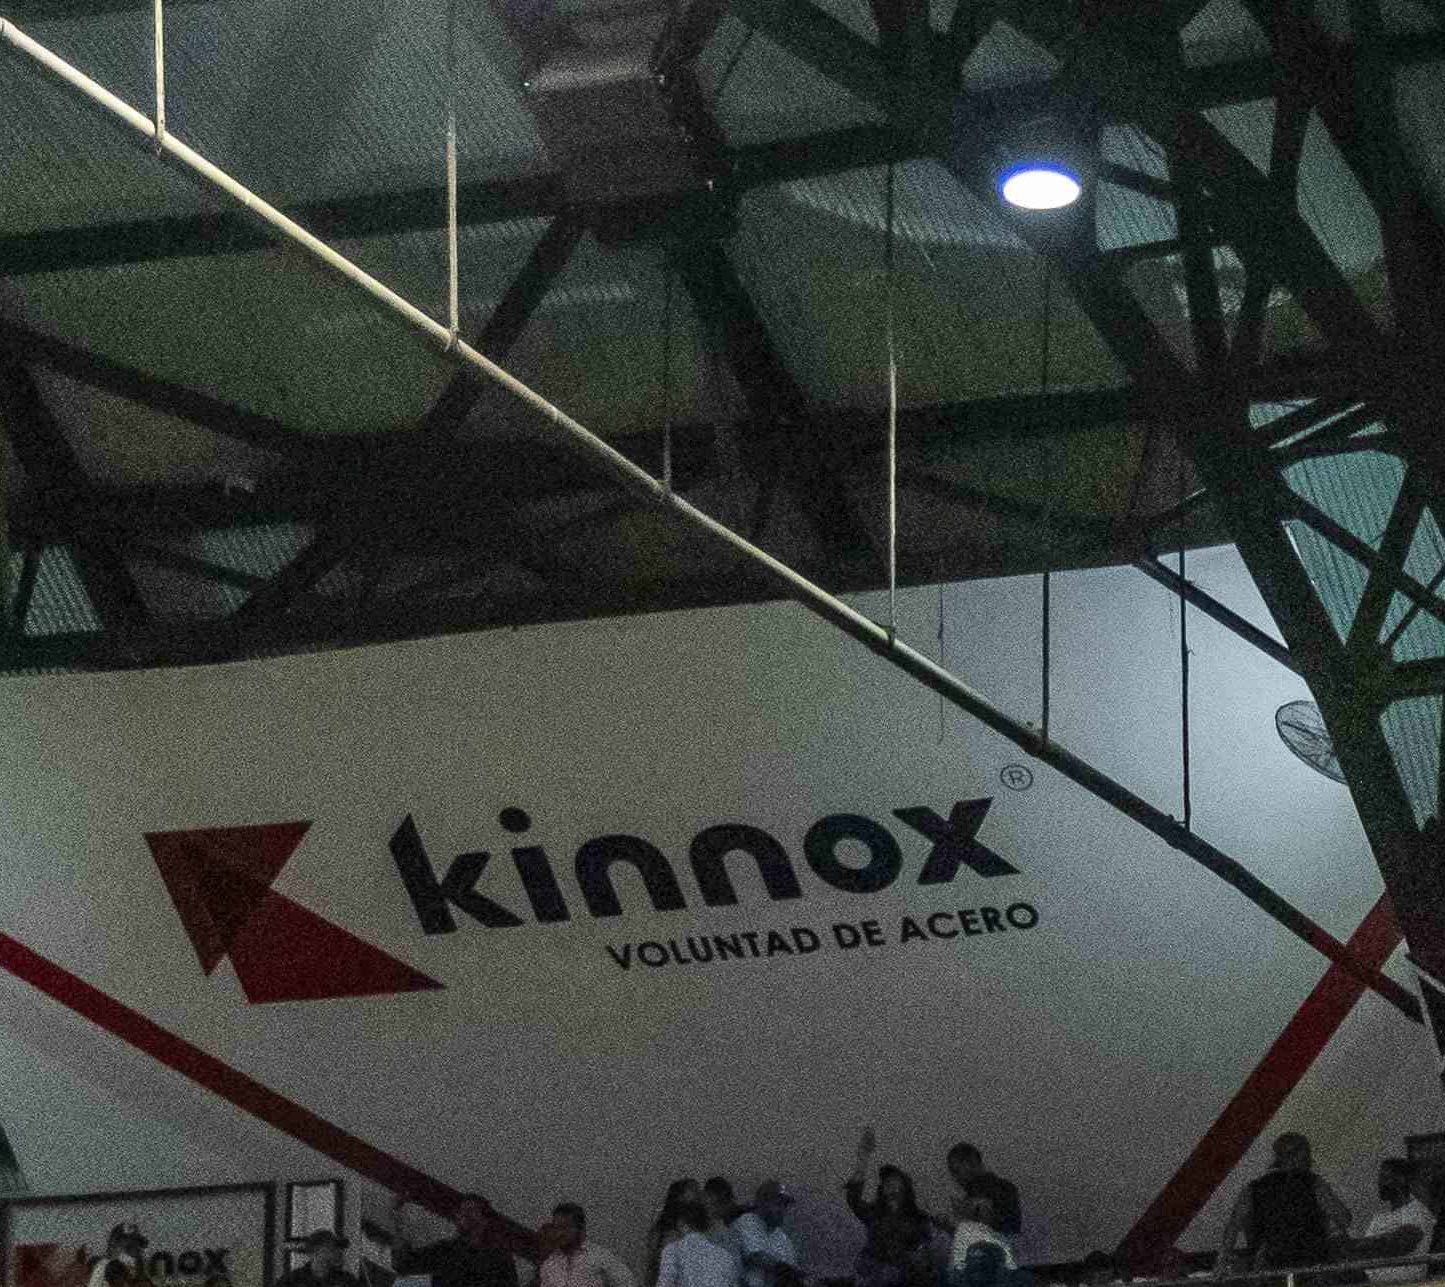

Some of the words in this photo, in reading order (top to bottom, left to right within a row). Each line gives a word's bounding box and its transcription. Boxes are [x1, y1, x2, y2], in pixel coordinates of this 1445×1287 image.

[388, 796, 1020, 936] kinnox
[605, 927, 821, 971] VOLUNTAD
[833, 920, 886, 950] DE
[899, 902, 1040, 943] ACERO
